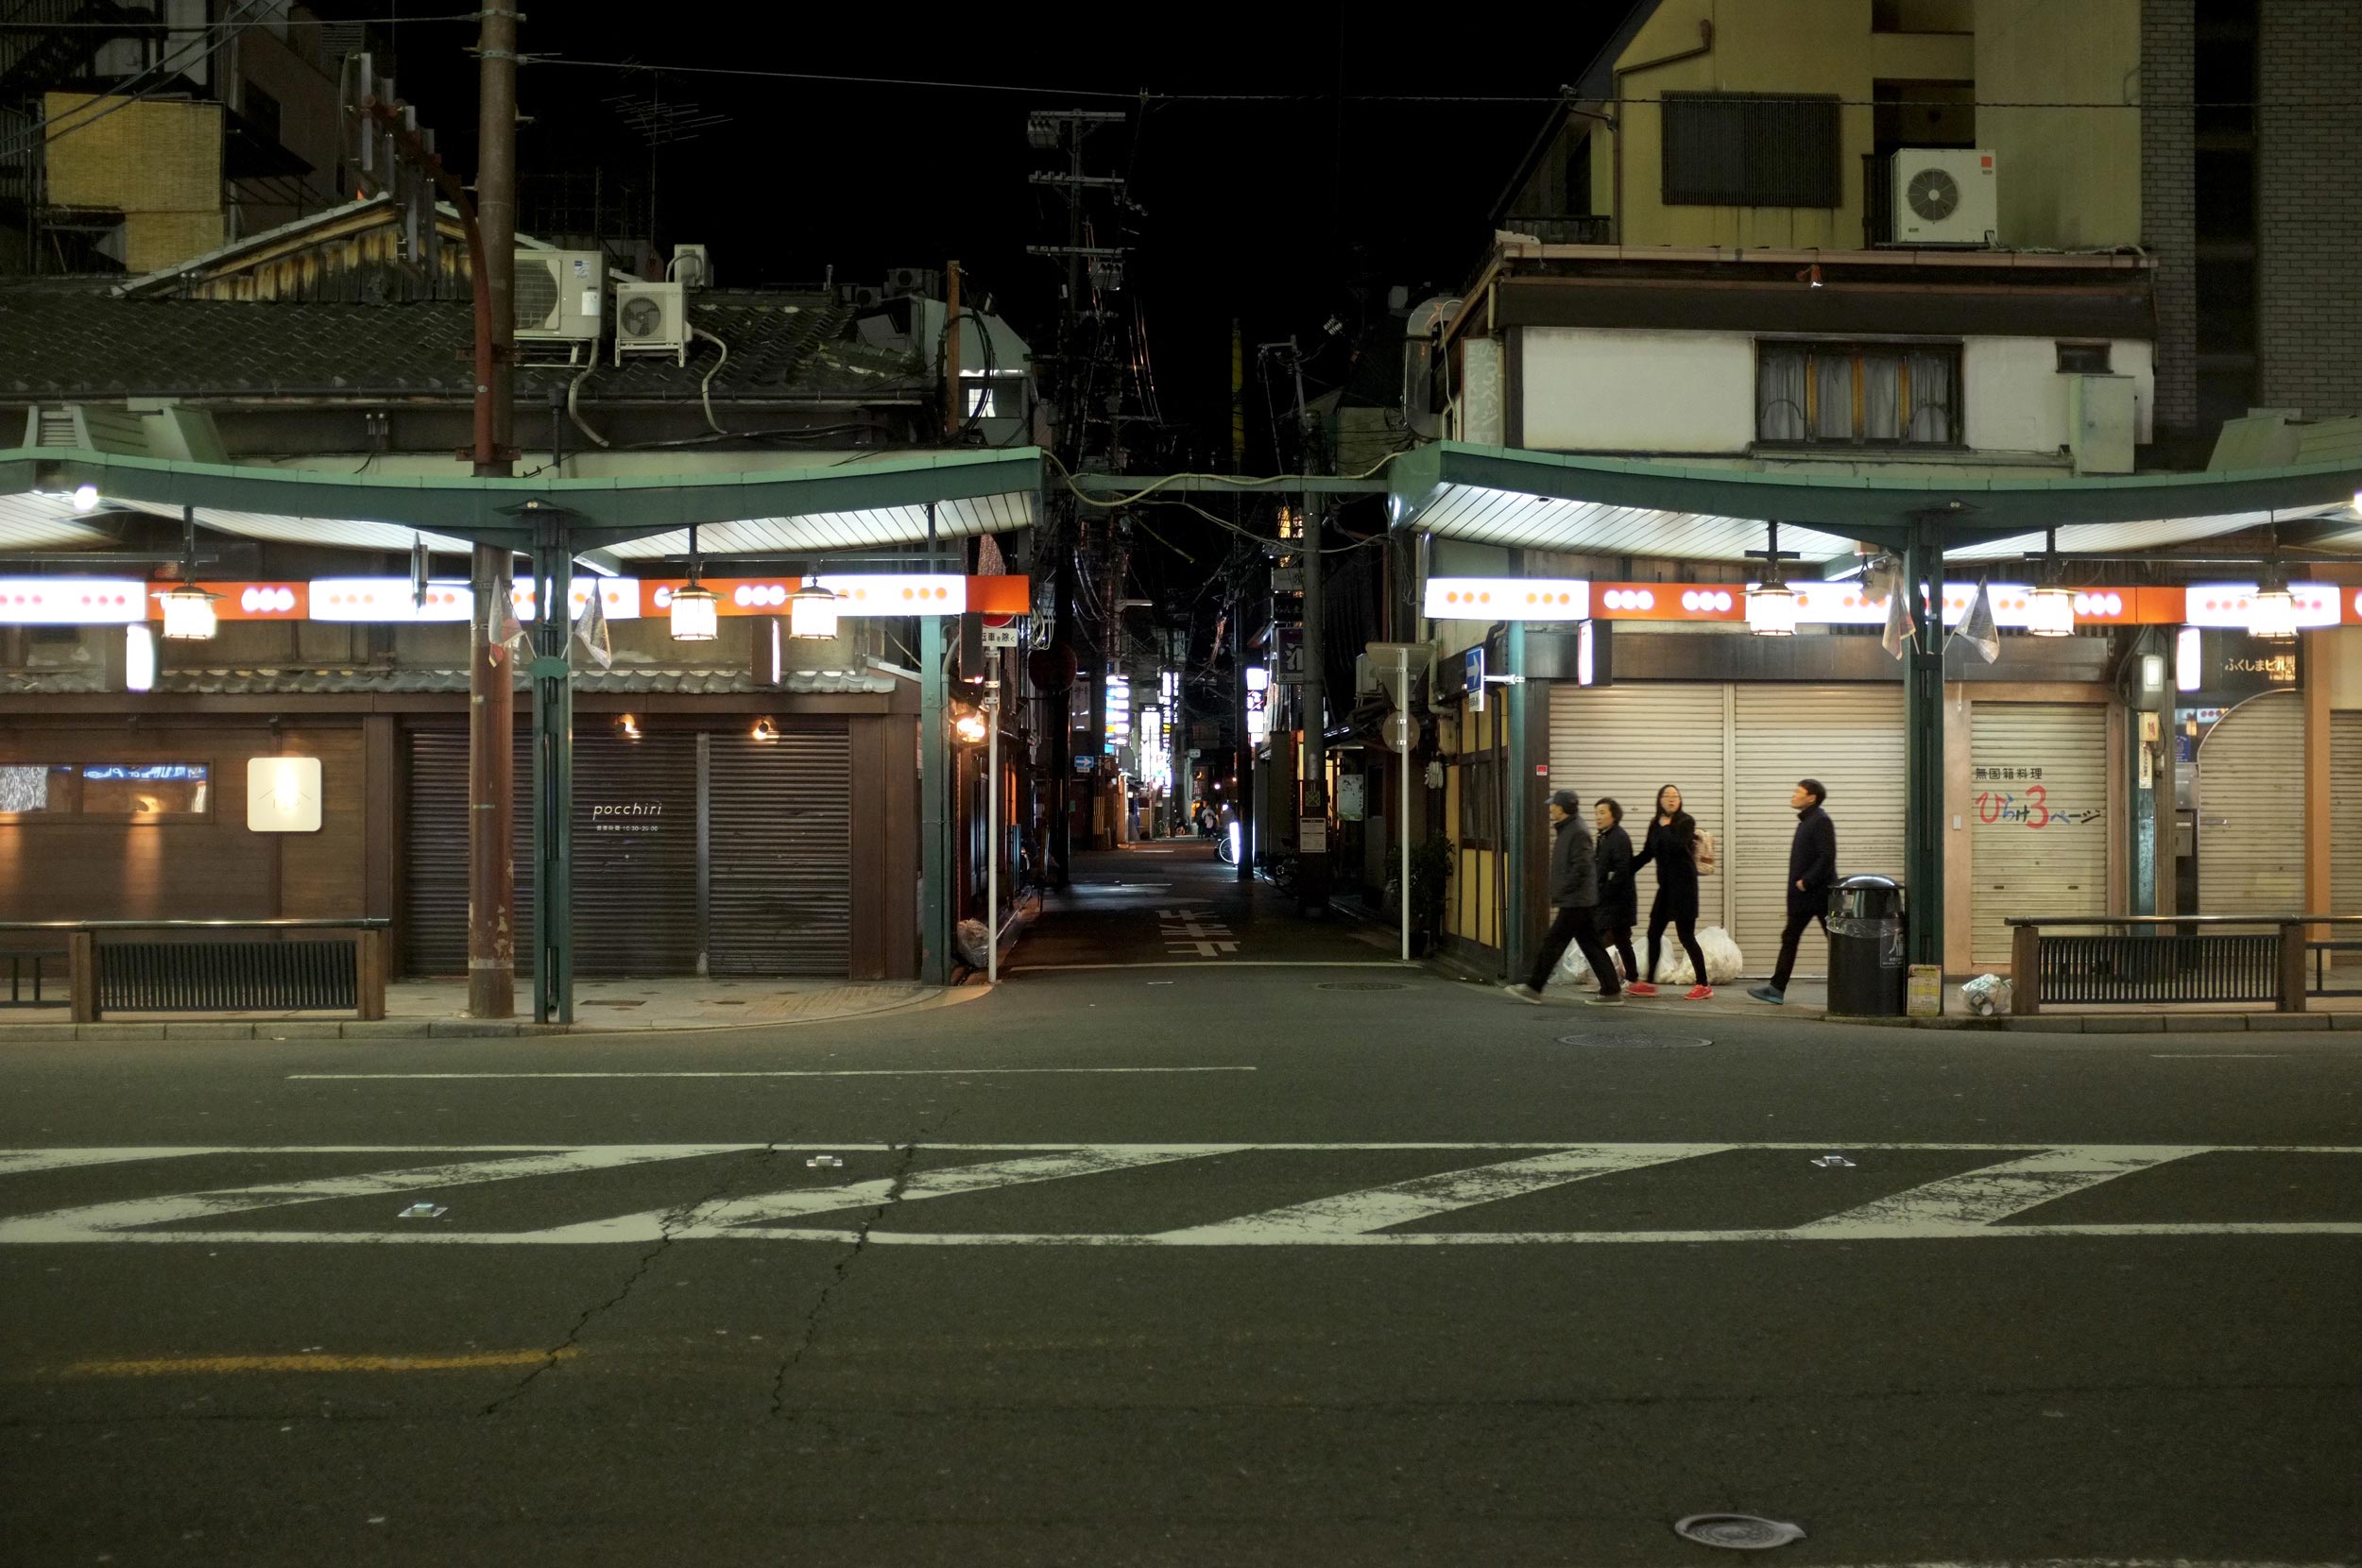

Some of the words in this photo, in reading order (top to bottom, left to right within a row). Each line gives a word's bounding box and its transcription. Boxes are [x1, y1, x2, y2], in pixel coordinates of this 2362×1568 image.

[2224, 658, 2285, 672] ふくしまビル
[1975, 767, 2043, 780] 無国籍料理
[592, 803, 662, 821] pocchiri
